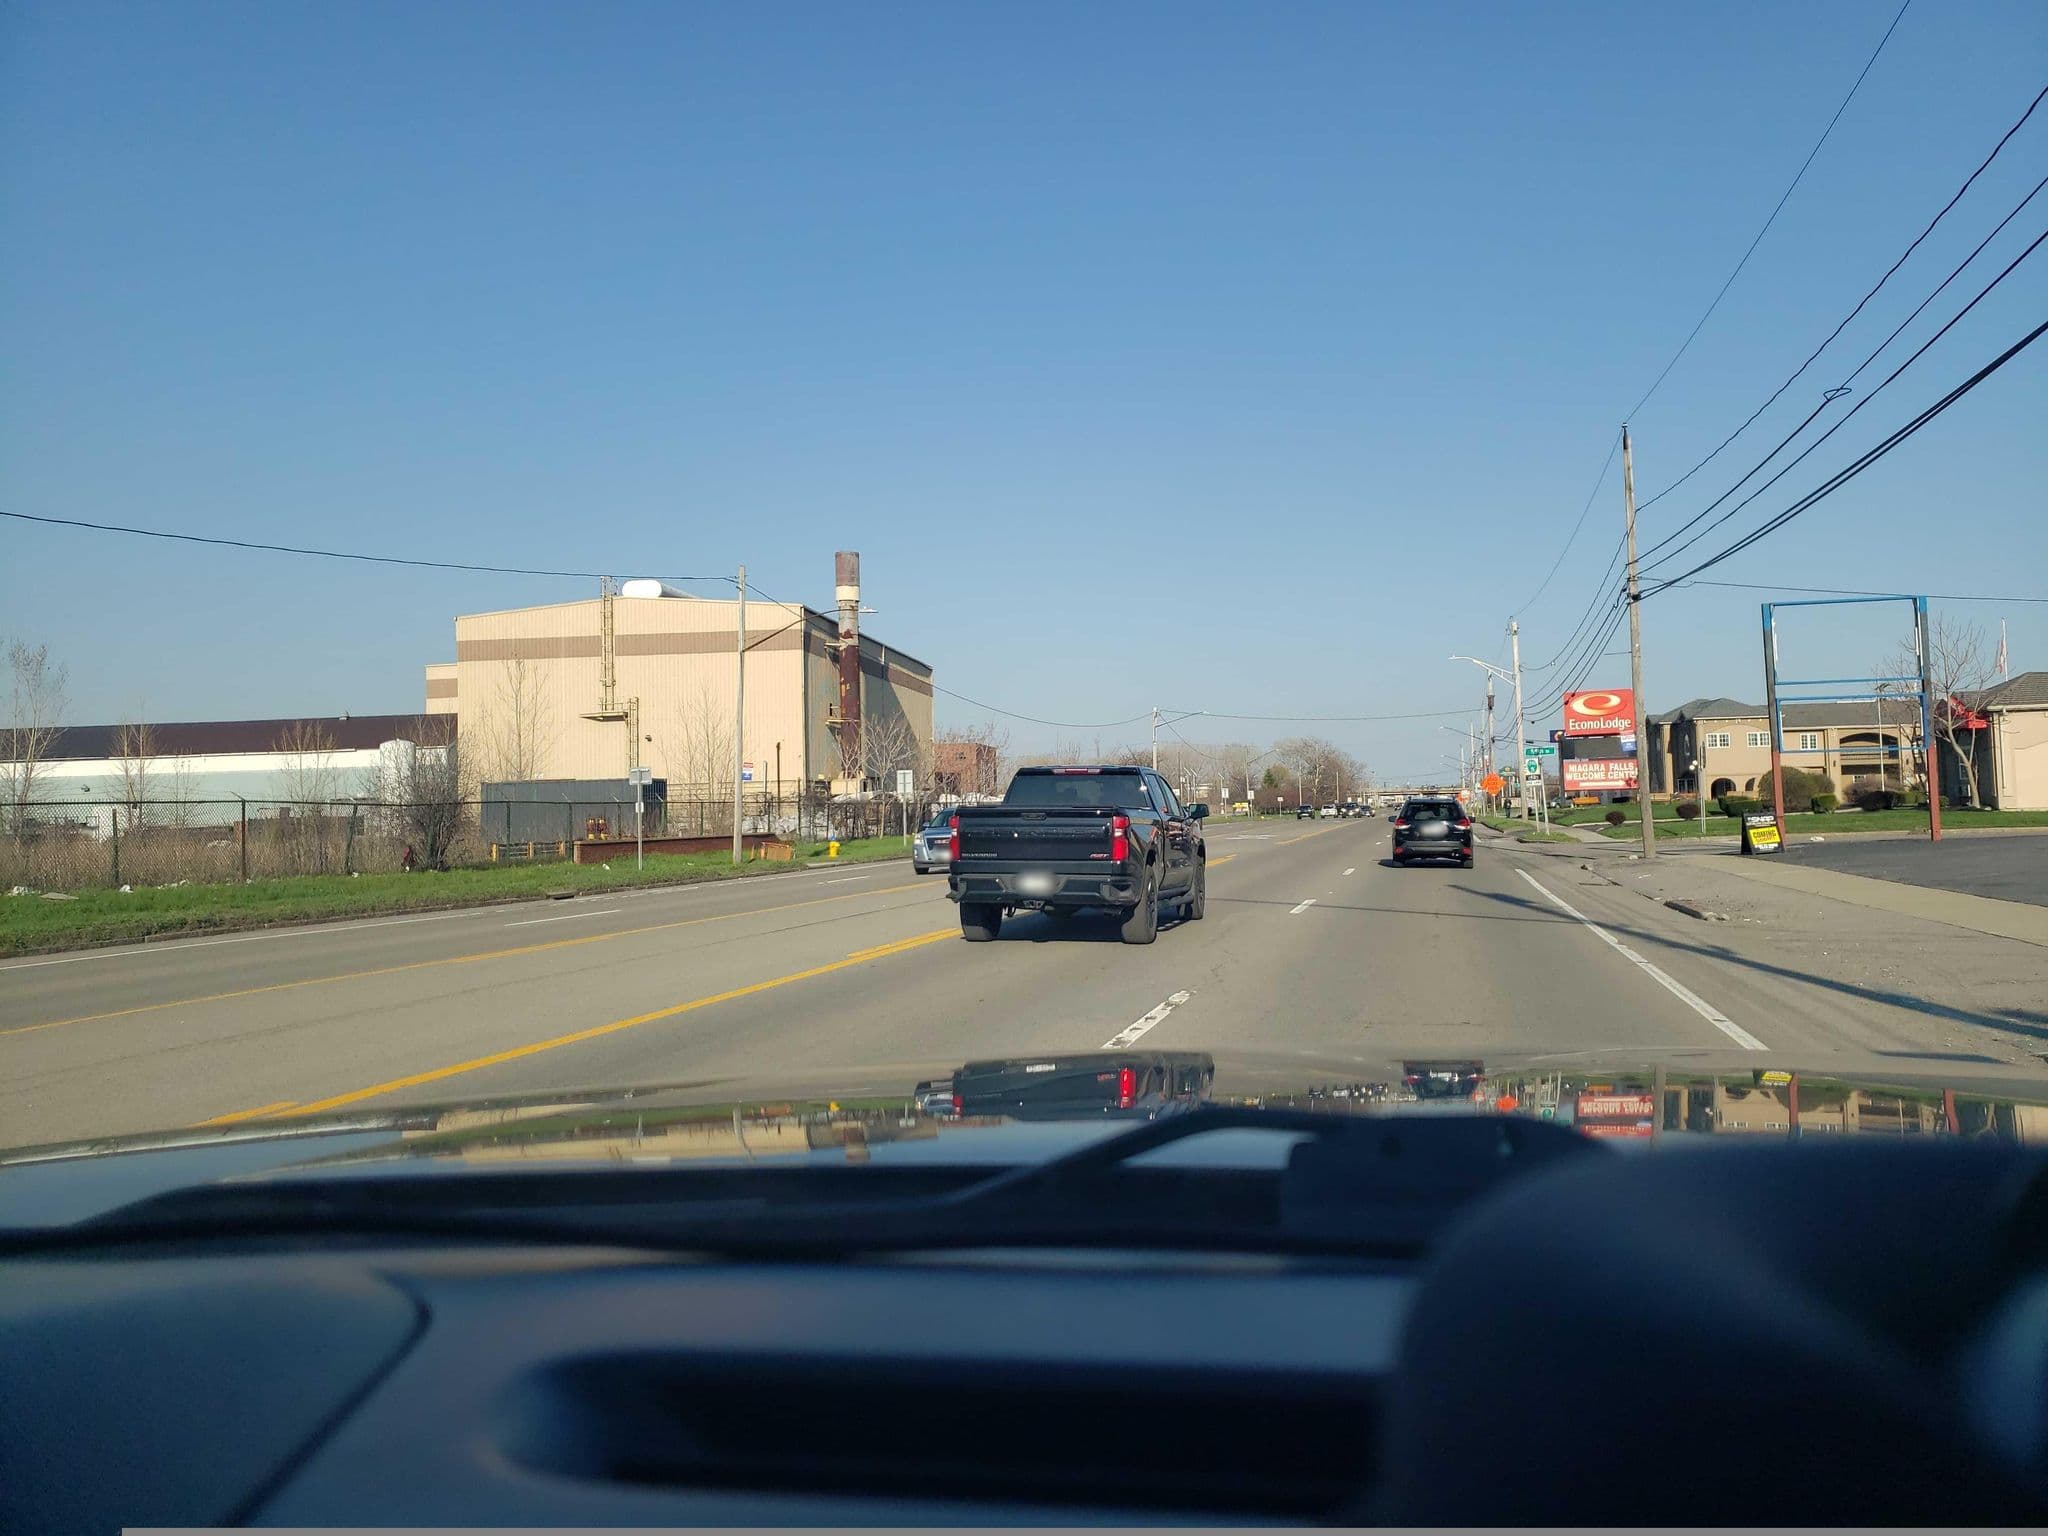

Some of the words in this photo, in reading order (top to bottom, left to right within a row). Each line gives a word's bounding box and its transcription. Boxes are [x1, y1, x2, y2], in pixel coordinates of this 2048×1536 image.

[1569, 717, 1632, 730] EconoLodge
[1568, 763, 1606, 772] NIAGARA
[1609, 762, 1634, 771] FALLS
[1566, 771, 1606, 780] WELCOME
